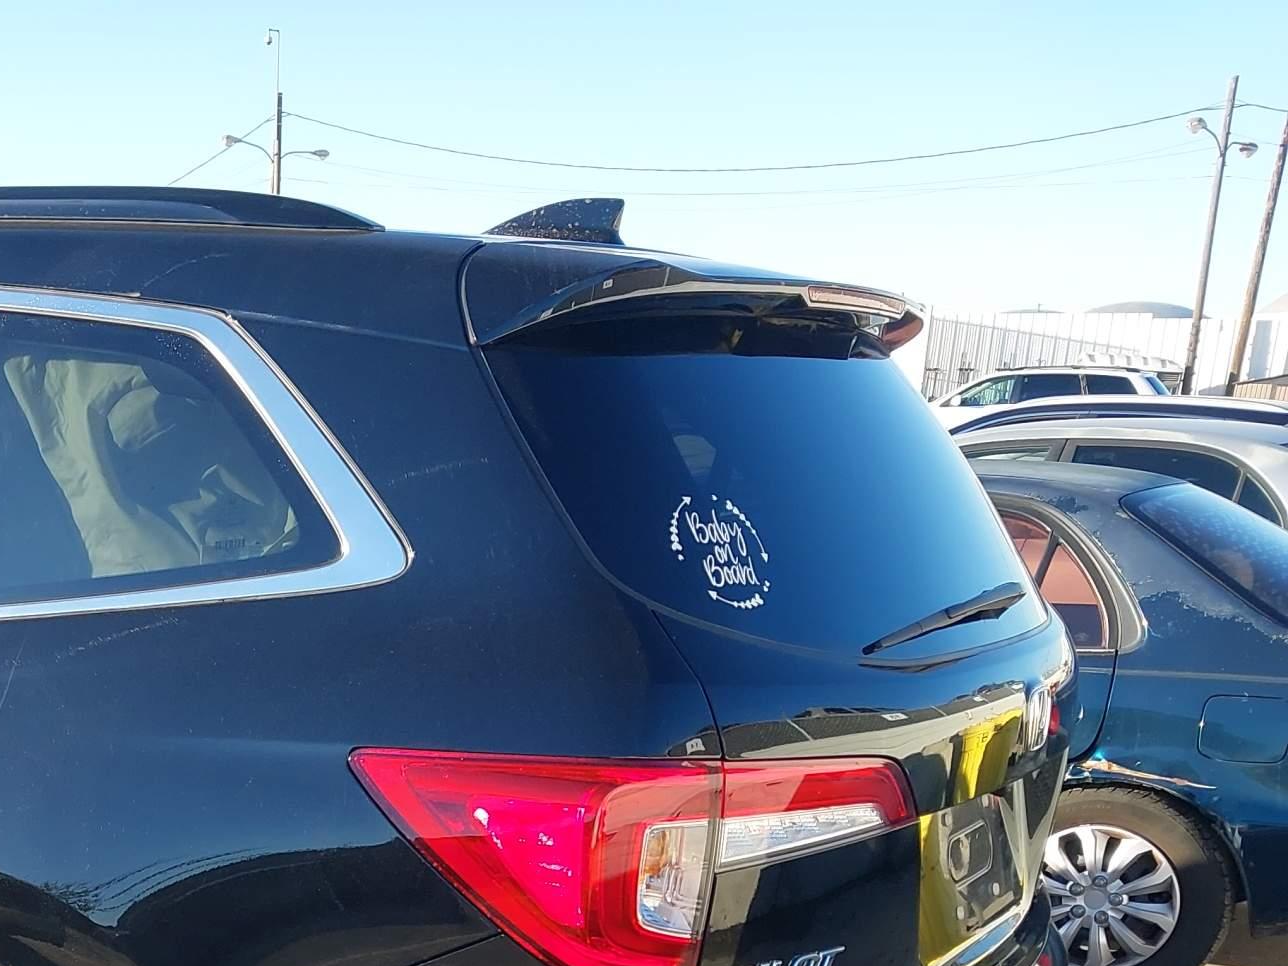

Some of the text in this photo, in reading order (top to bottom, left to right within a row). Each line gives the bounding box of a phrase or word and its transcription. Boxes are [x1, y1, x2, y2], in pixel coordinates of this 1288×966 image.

[684, 509, 747, 556] Baby
[702, 554, 760, 588] Board
[714, 543, 739, 565] on
